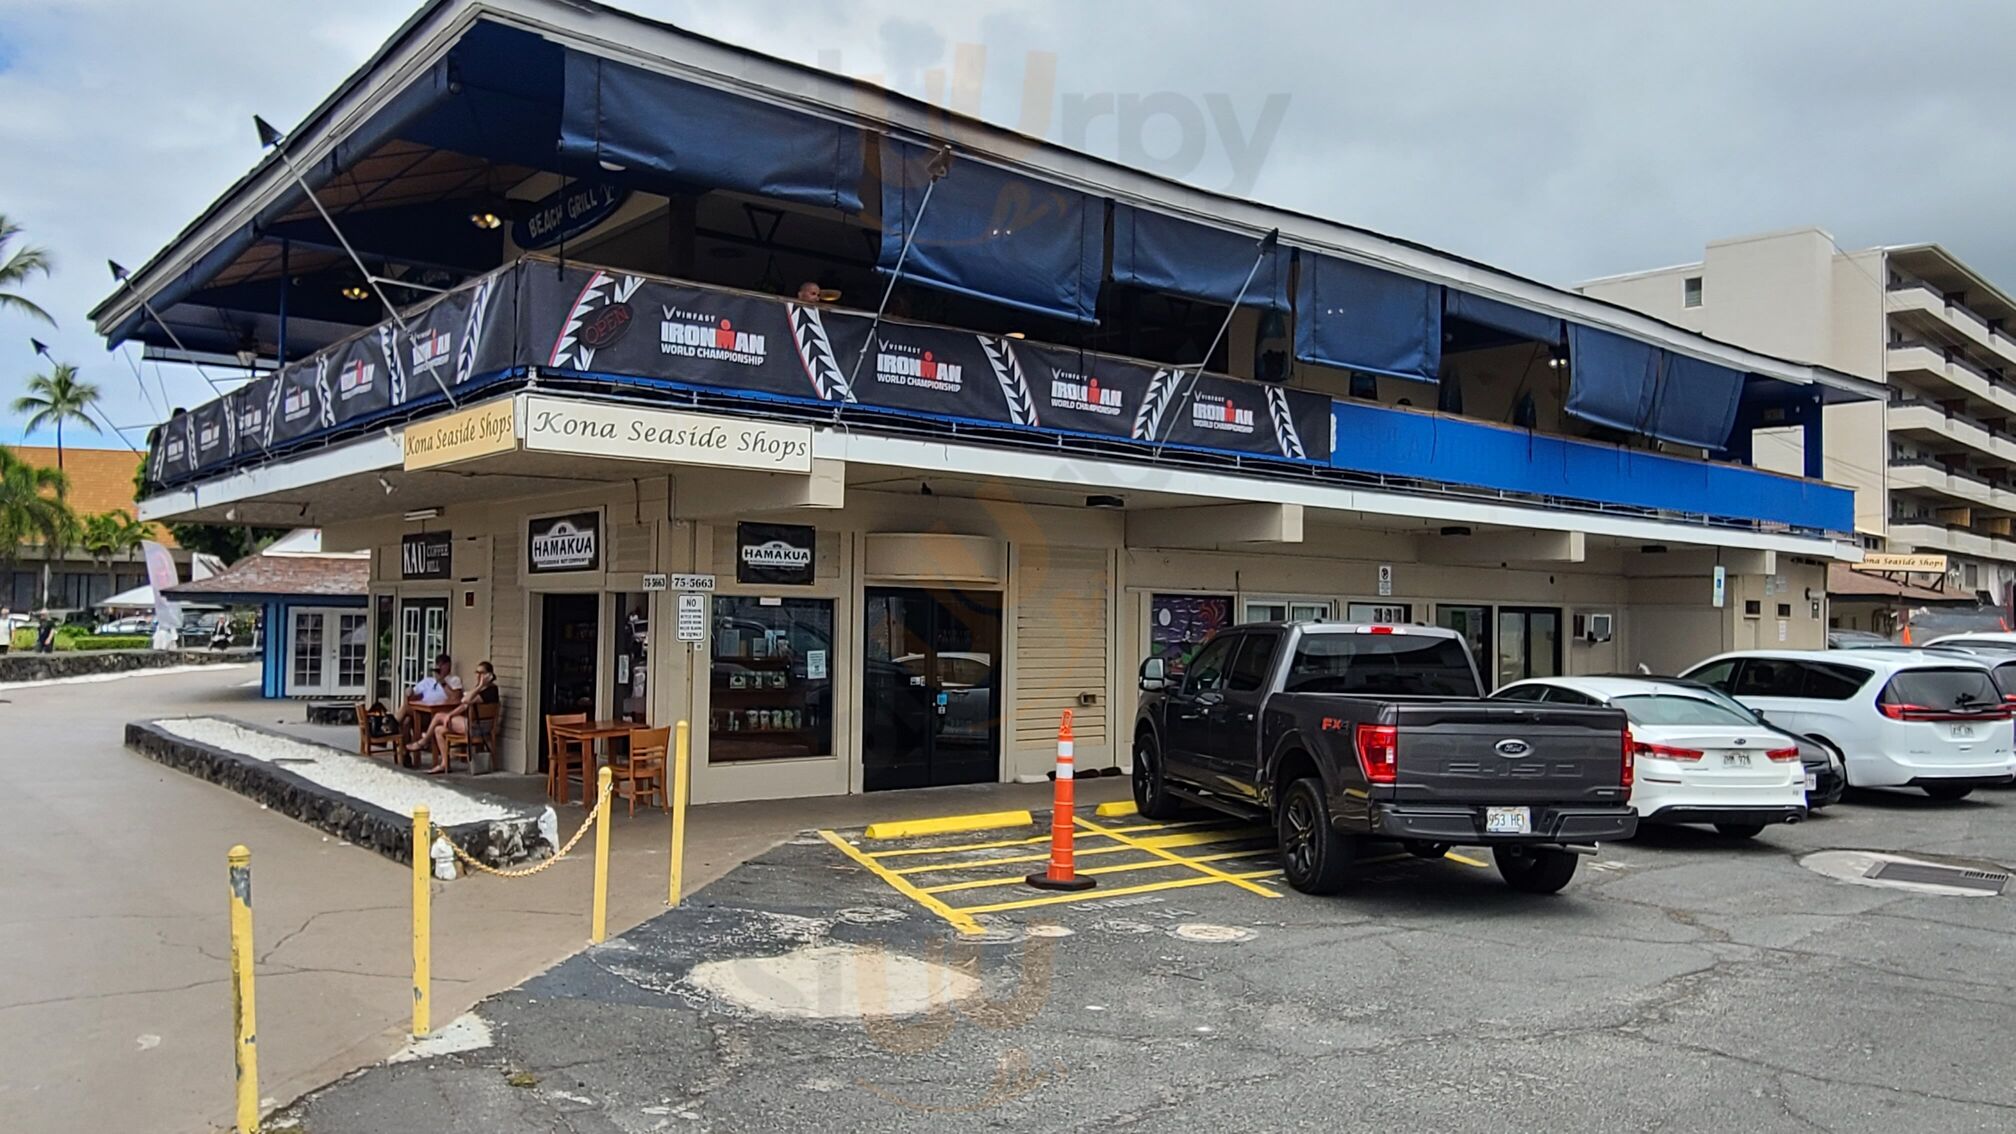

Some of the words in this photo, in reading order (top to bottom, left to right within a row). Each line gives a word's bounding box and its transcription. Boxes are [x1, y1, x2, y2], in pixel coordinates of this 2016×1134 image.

[528, 204, 563, 239] BEACH
[568, 189, 598, 219] GRILL
[676, 310, 715, 322] VINFAST
[660, 319, 766, 355] IRONMAN
[661, 343, 695, 356] WORLD
[697, 347, 764, 366] CHAMPIONSHIP
[877, 351, 962, 383] IRONMAN
[877, 373, 906, 385] WORLD
[907, 377, 961, 392] CHAMPIONSHIP
[1051, 399, 1075, 409] WORLD
[406, 435, 433, 456] Kona
[436, 417, 475, 449] Seaside
[479, 412, 512, 443] Shops
[533, 411, 617, 439] Kona
[627, 420, 727, 449] Seaside
[737, 431, 807, 462] Shops
[534, 536, 592, 557] HAMAKUA
[744, 549, 809, 561] HAMAKUA
[674, 578, 713, 588] 75-5663
[686, 598, 697, 607] NO
[1504, 743, 1524, 753] Ford
[1489, 813, 1505, 826] 953
